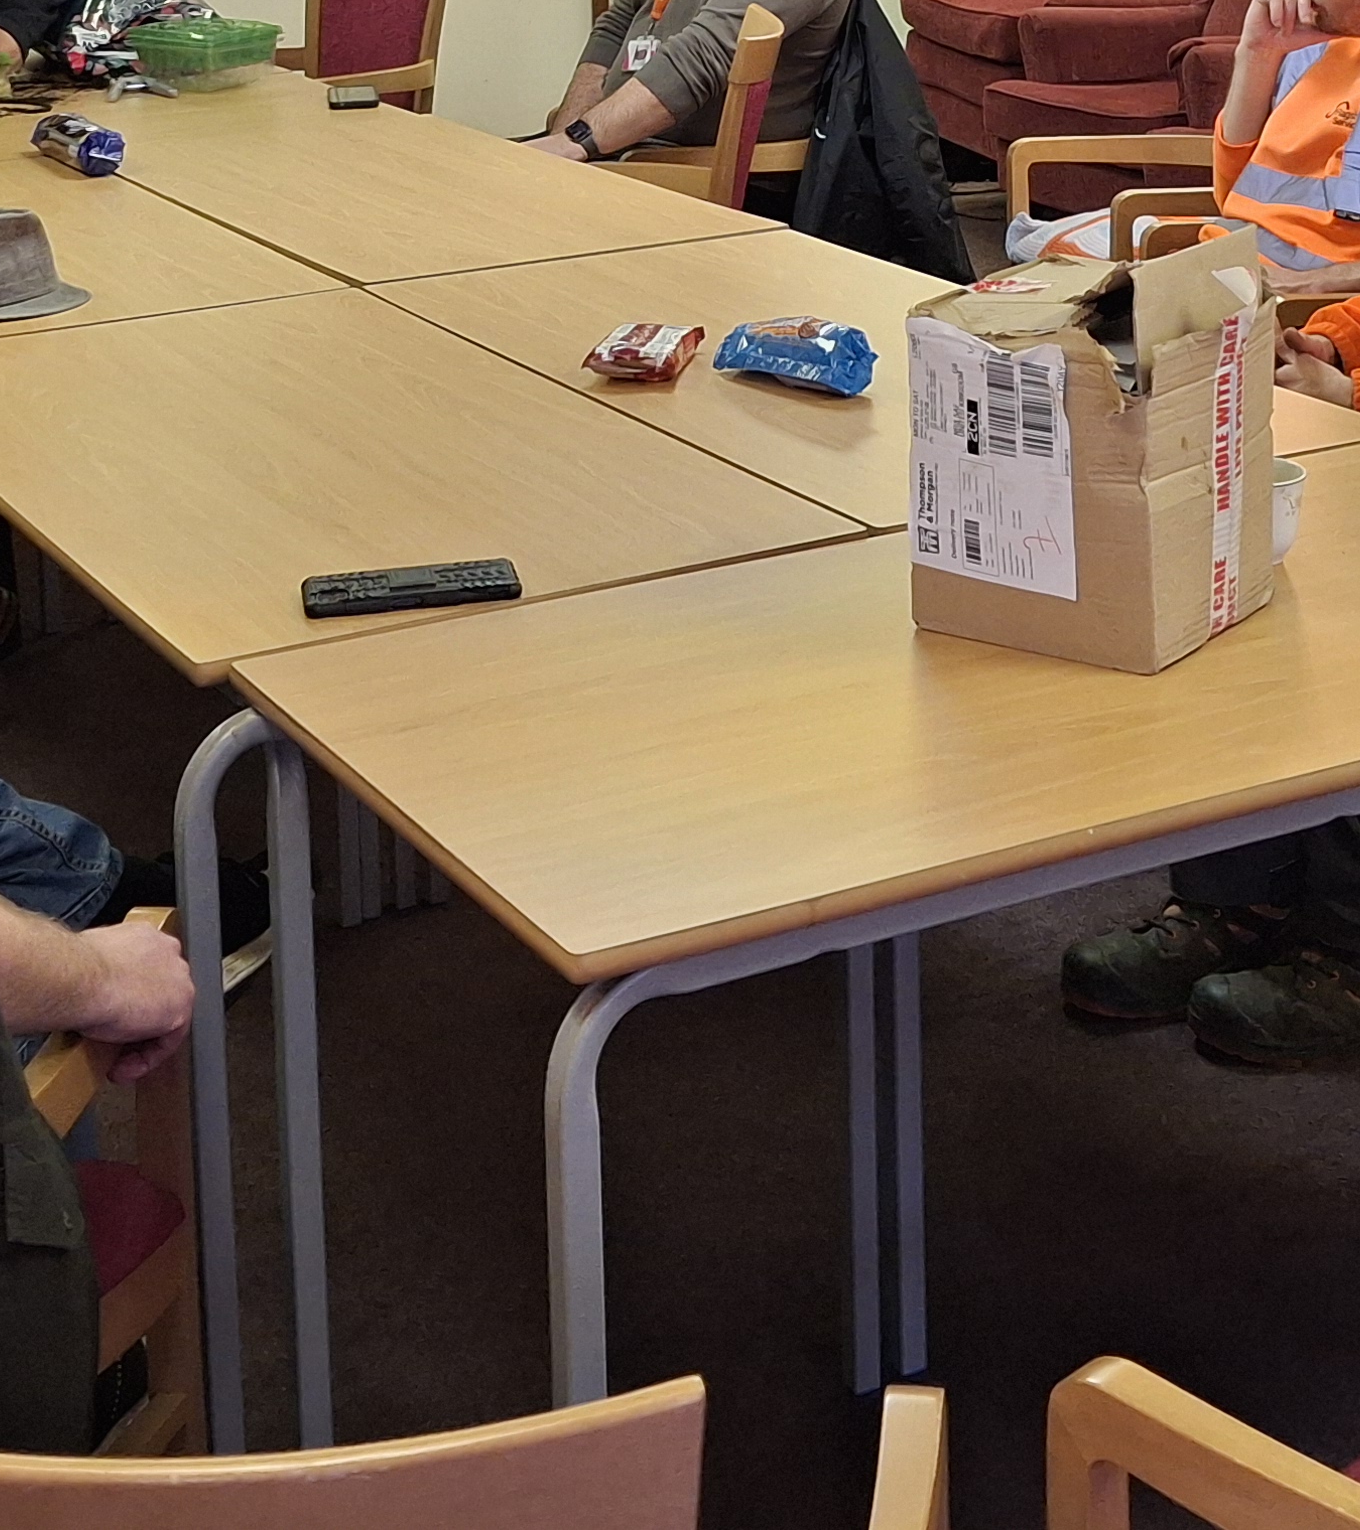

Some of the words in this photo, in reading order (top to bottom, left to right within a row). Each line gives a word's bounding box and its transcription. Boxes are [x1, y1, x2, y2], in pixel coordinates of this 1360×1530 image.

[1220, 316, 1239, 368] CARE
[968, 411, 978, 443] 2CN
[1216, 372, 1231, 429] WITH
[918, 462, 926, 520] Thompson
[926, 470, 935, 512] Morgan
[1215, 431, 1230, 513] HANDLE
[1213, 556, 1227, 612] CARE
